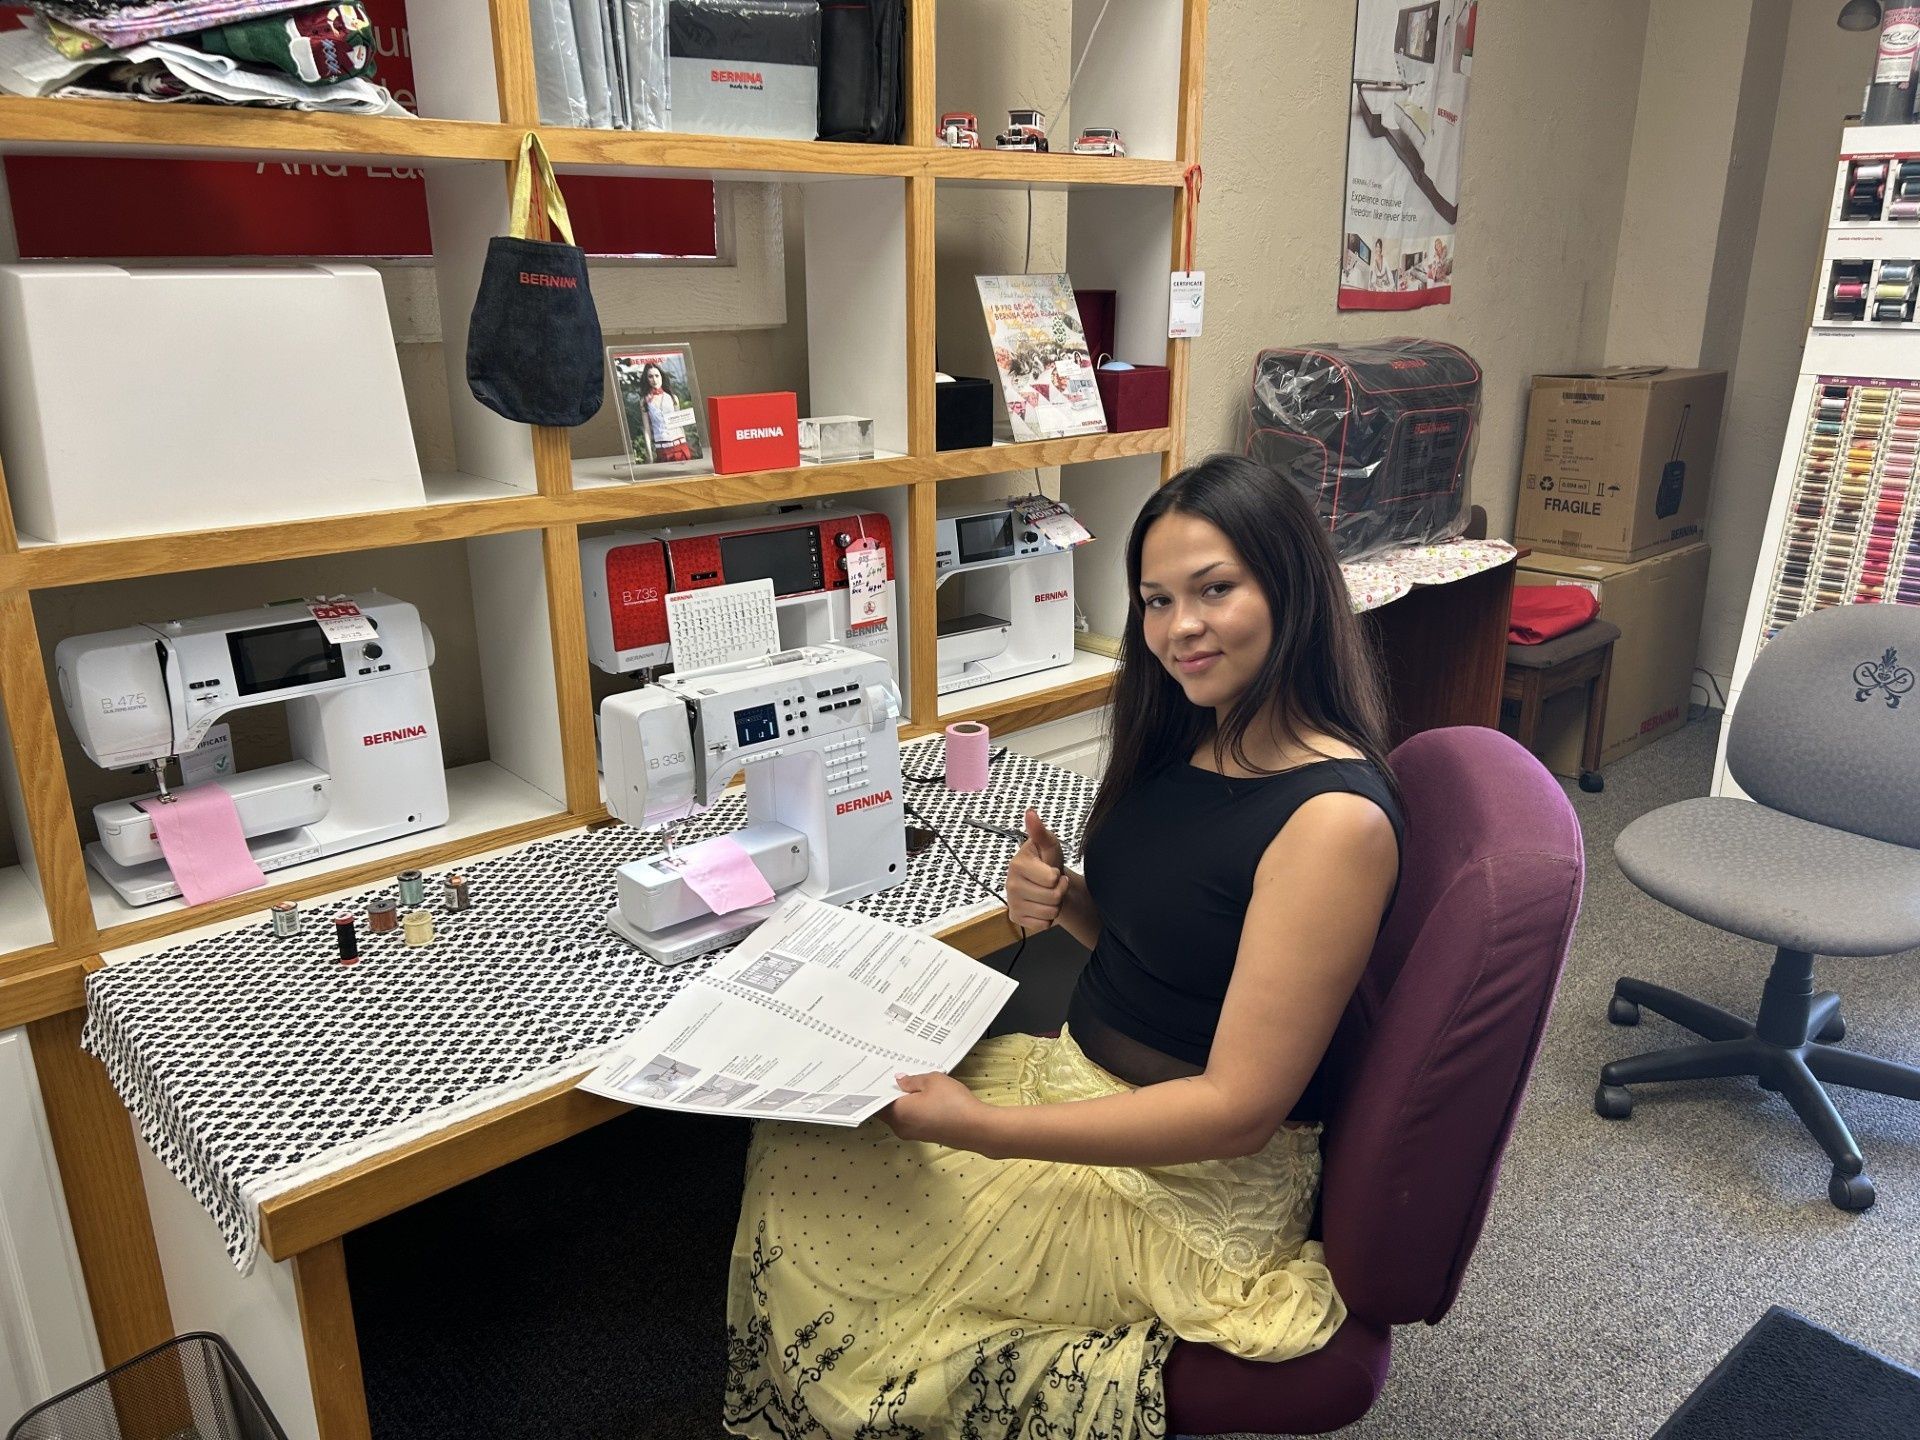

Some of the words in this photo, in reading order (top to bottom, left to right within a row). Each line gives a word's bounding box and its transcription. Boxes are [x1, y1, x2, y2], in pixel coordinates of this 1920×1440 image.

[711, 70, 763, 84] BERNINA
[1437, 107, 1459, 124] BERNINA
[1351, 190, 1379, 205] Experience
[1381, 198, 1402, 207] creative
[1350, 206, 1372, 218] freedom
[1373, 209, 1383, 220] like
[1384, 213, 1400, 222] never
[519, 272, 577, 288] BERNINA
[735, 426, 784, 441] BERNINA
[1027, 506, 1064, 520] MONTH
[1544, 497, 1602, 516] FRAGILE
[1671, 525, 1698, 541] BERNINA
[622, 591, 632, 603] B
[635, 586, 658, 600] 735
[670, 594, 693, 602] BERNINA
[1034, 590, 1068, 603] BERNINA
[317, 606, 358, 617] SALE
[846, 622, 889, 638] BERNINA
[625, 652, 655, 662] BERNINA
[102, 698, 113, 710] B
[118, 693, 147, 706] 475
[1639, 705, 1679, 735] BERNINA
[362, 724, 427, 747] BERNINA
[650, 758, 660, 769] B
[663, 751, 686, 766] 335
[836, 790, 893, 816] BERNINA
